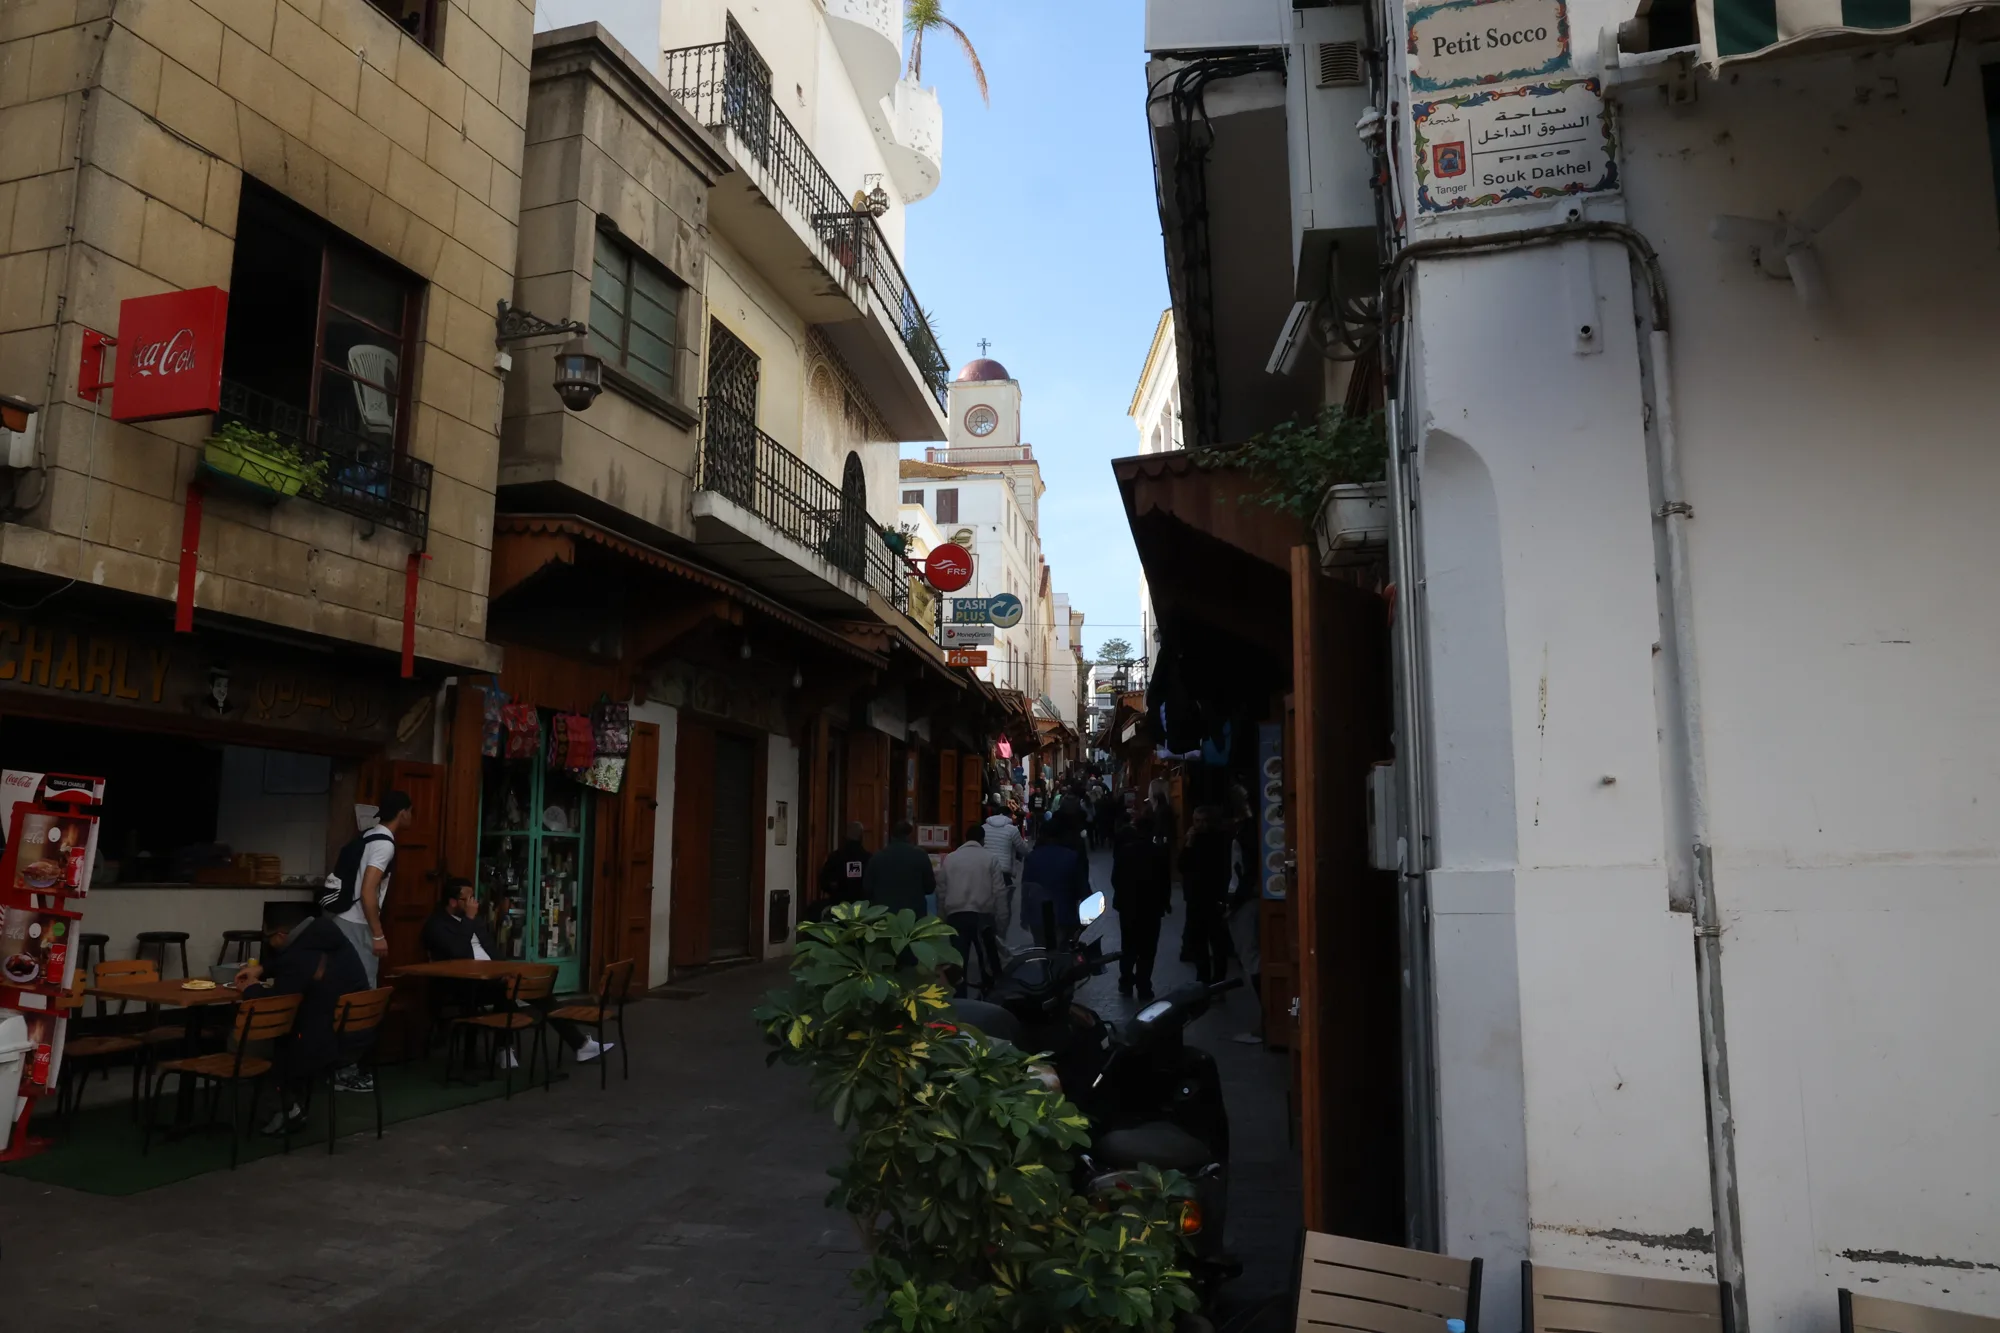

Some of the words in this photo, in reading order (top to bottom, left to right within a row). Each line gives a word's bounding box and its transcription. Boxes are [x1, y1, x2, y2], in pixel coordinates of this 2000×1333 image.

[1432, 32, 1481, 57] Petit
[1486, 27, 1547, 49] Socco
[1429, 113, 1460, 126] طنجة
[1495, 107, 1566, 121] ساحة
[1537, 115, 1589, 137] السوق
[1478, 124, 1531, 145] الداخل
[1499, 149, 1571, 163] Place
[1483, 170, 1526, 186] Souk
[1532, 161, 1591, 179] Dakhel
[1435, 184, 1467, 195] Tanger
[956, 600, 987, 610] CASH
[956, 611, 986, 621] PLUS
[0, 622, 172, 704] CHARLY
[951, 652, 969, 664] ria
